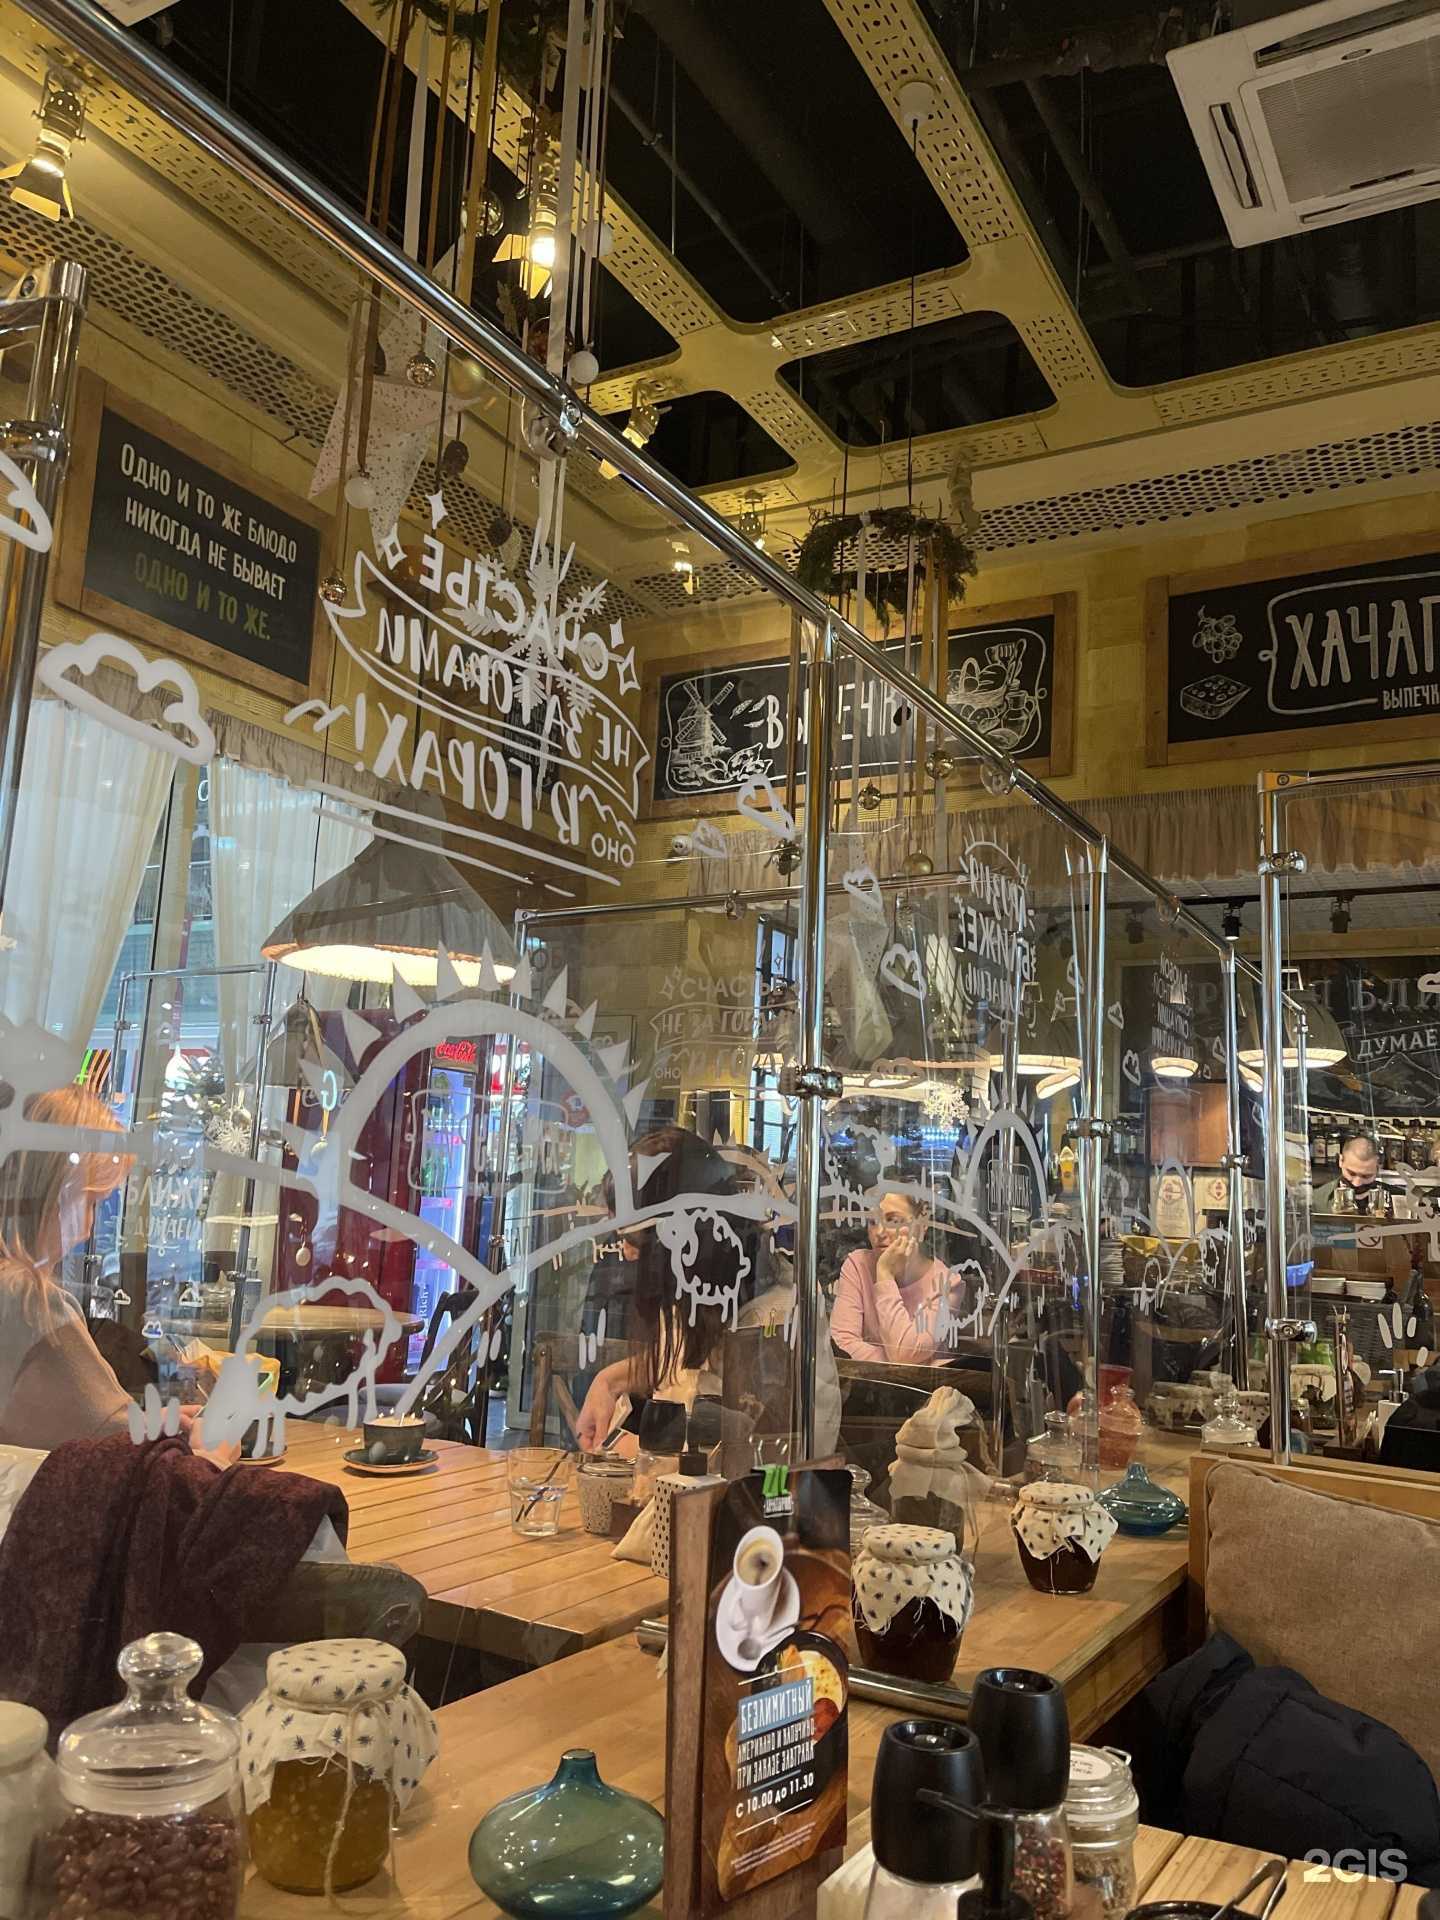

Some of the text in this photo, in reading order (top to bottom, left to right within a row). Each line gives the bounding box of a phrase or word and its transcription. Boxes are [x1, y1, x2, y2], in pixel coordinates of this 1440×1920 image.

[125, 496, 286, 601] НИКОГДА НЕ БЫВАЕТ
[177, 478, 189, 508] И
[196, 487, 215, 520] ТО
[220, 501, 242, 536] ЖЕ
[247, 516, 297, 564] БЛЮДО
[196, 581, 209, 612] И
[217, 590, 238, 624] ТО
[243, 602, 271, 641] ЖЕ.
[740, 1680, 813, 1735] БЕЗЛИМИТНЫЙ
[737, 1764, 752, 1791] ПРИ
[747, 1789, 773, 1815] 10.00
[790, 1773, 814, 1795] 11.30
